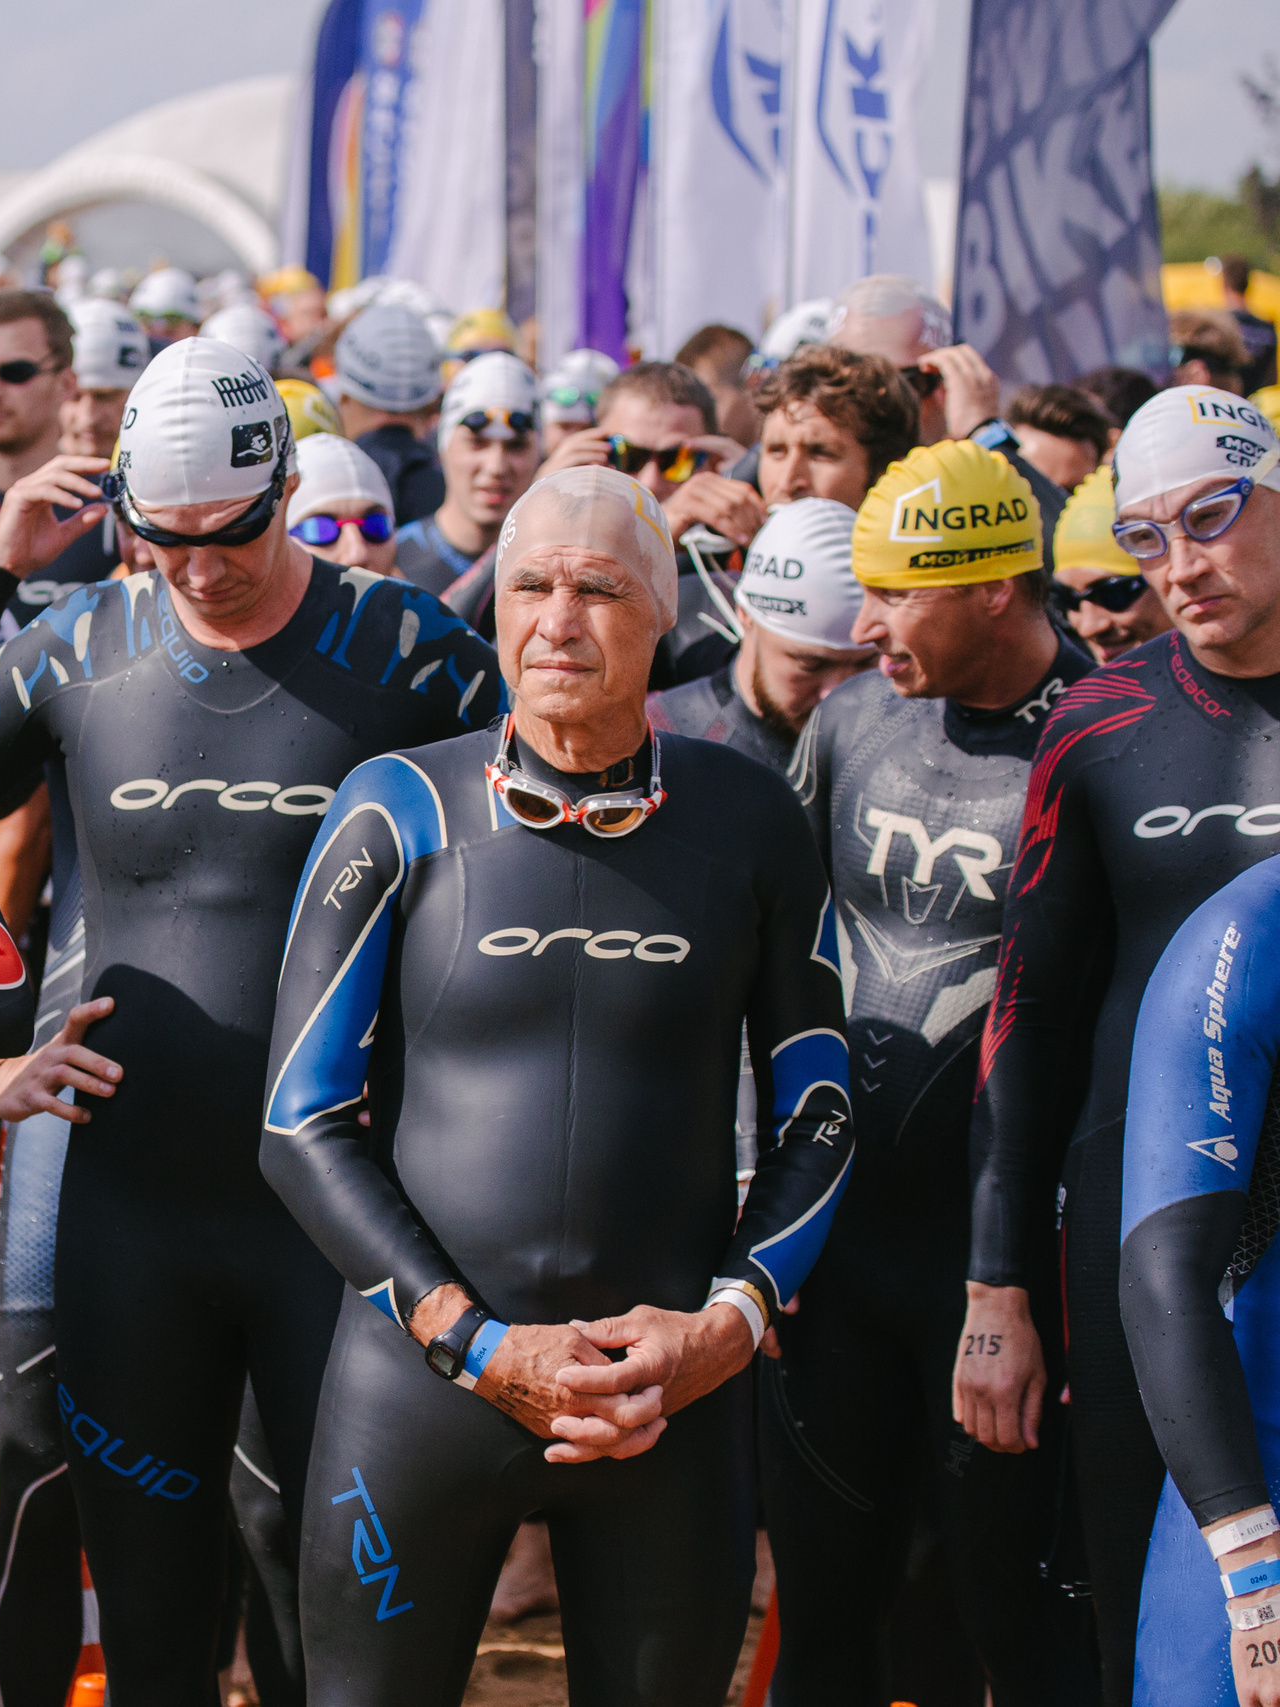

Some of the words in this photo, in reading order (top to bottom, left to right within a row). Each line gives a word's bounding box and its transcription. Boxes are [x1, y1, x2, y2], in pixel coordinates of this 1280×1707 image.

[901, 498, 1028, 531] INGRAD
[157, 589, 210, 684] equip
[110, 778, 338, 816] orca
[865, 807, 1004, 901] TYR
[477, 926, 691, 964] orca
[1208, 1046, 1233, 1123] Aqua
[964, 1334, 1003, 1356] 215
[57, 1382, 202, 1500] equip
[1246, 1522, 1264, 1536] ELITE
[1249, 1573, 1268, 1585] 0240
[1245, 1640, 1280, 1669] 20
